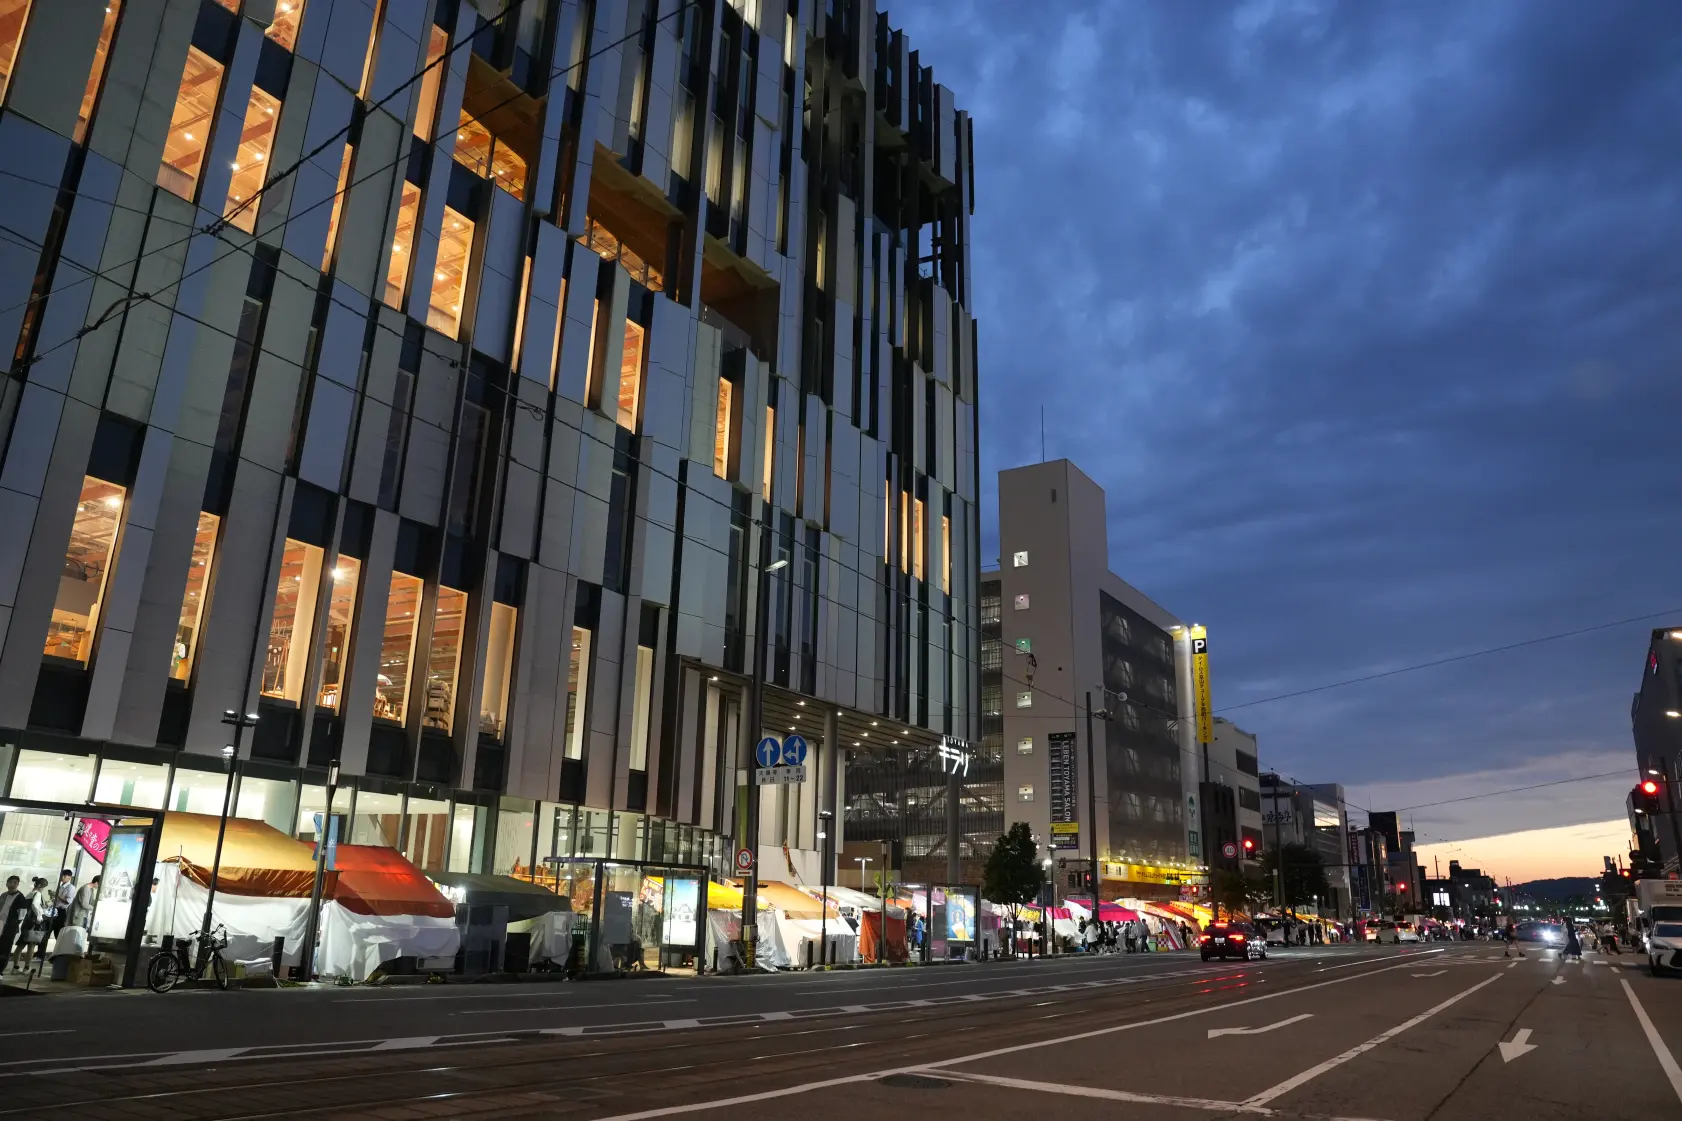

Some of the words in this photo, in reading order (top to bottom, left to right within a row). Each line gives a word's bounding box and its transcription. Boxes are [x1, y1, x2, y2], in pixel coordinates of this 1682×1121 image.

[1194, 639, 1205, 653] P
[938, 736, 969, 777] キラリ
[1062, 740, 1070, 765] LEBEN
[1063, 765, 1071, 797] TOYAMA
